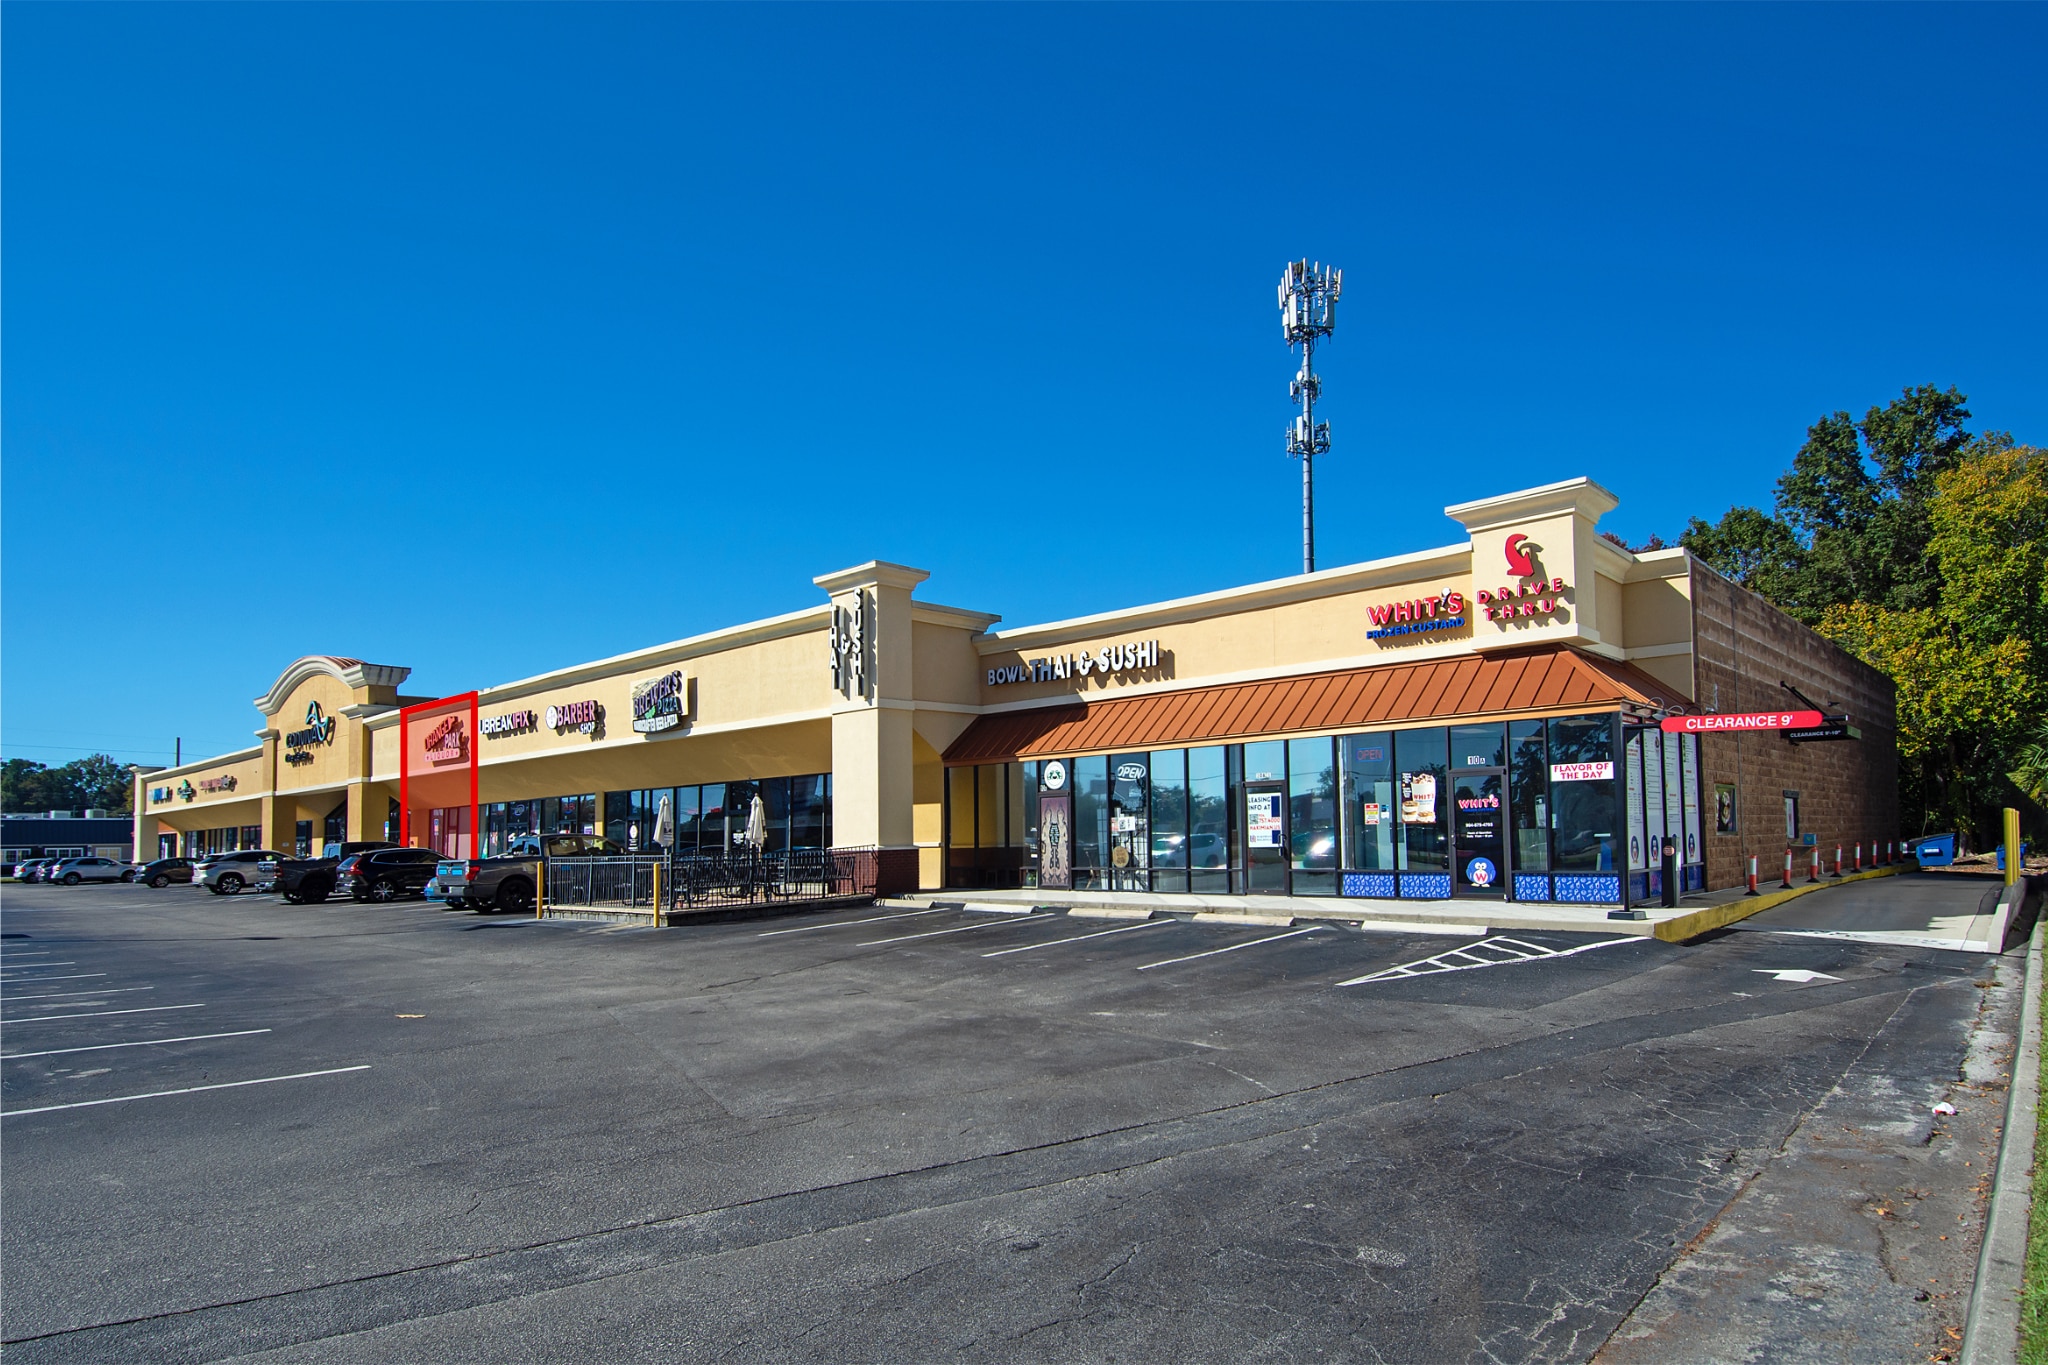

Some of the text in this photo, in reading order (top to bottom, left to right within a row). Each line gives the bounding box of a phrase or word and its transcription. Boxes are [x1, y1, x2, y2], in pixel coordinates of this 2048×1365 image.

[1477, 577, 1564, 604] DRIVE
[1366, 588, 1464, 626] WHIT'S
[1483, 598, 1556, 621] THRU
[1366, 617, 1465, 640] FROZEN CUSTARD
[829, 587, 863, 697] THAI & SUSHI
[987, 640, 1158, 686] BOWL THAI & SUSHI
[557, 700, 596, 727] BARBER
[657, 696, 679, 714] PIZZA
[580, 721, 596, 735] SHOP
[1685, 714, 1793, 730] CLEARANCE 9'
[444, 732, 460, 749] PARK
[430, 750, 455, 761] LIQUOR
[1357, 749, 1383, 760] OPEN
[1117, 765, 1143, 779] OPEN
[1553, 762, 1609, 772] FLAVOR OF
[1582, 771, 1603, 779] DAY
[1458, 794, 1499, 809] WHIT'S
